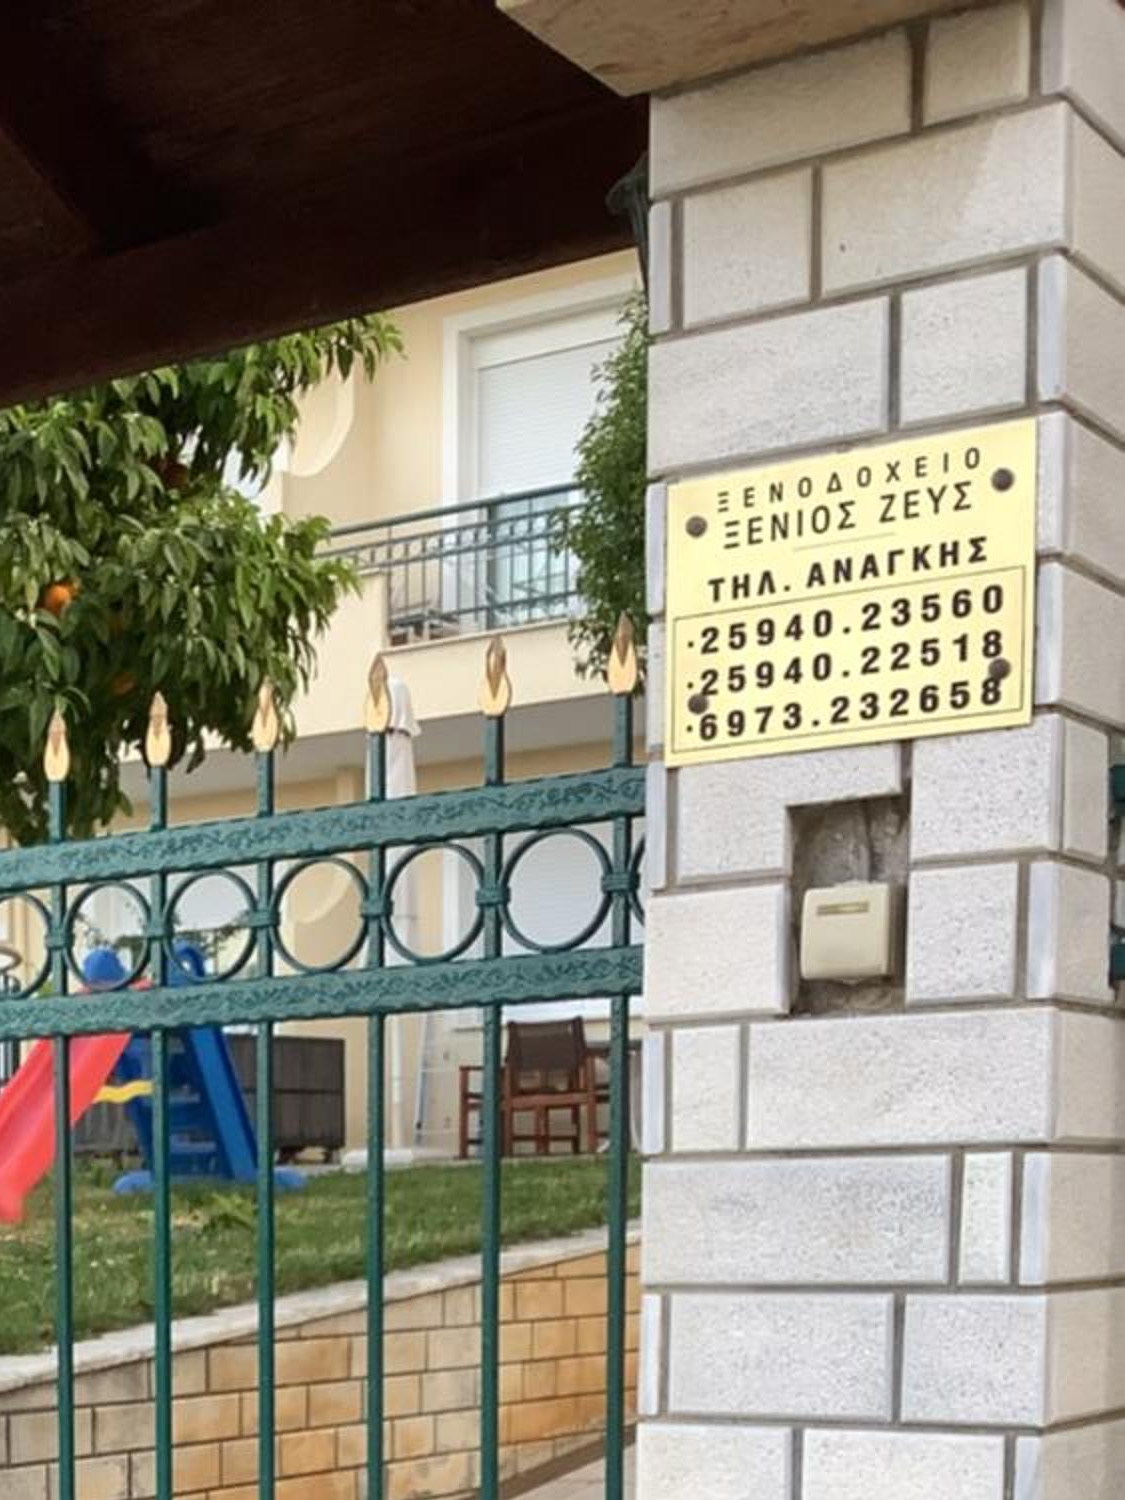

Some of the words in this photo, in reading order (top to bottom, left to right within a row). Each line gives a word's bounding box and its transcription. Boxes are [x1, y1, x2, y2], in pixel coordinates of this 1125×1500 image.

[717, 447, 980, 513] ΞΕΝΟΔΟΧΕΙΟ
[723, 501, 856, 550] ΞΕΝΙΟΣ
[879, 481, 973, 524] ΖΕΥΣ
[708, 570, 791, 603] ΤΗΛ.
[806, 536, 988, 589] ΑΝΑΓΚΗΣ
